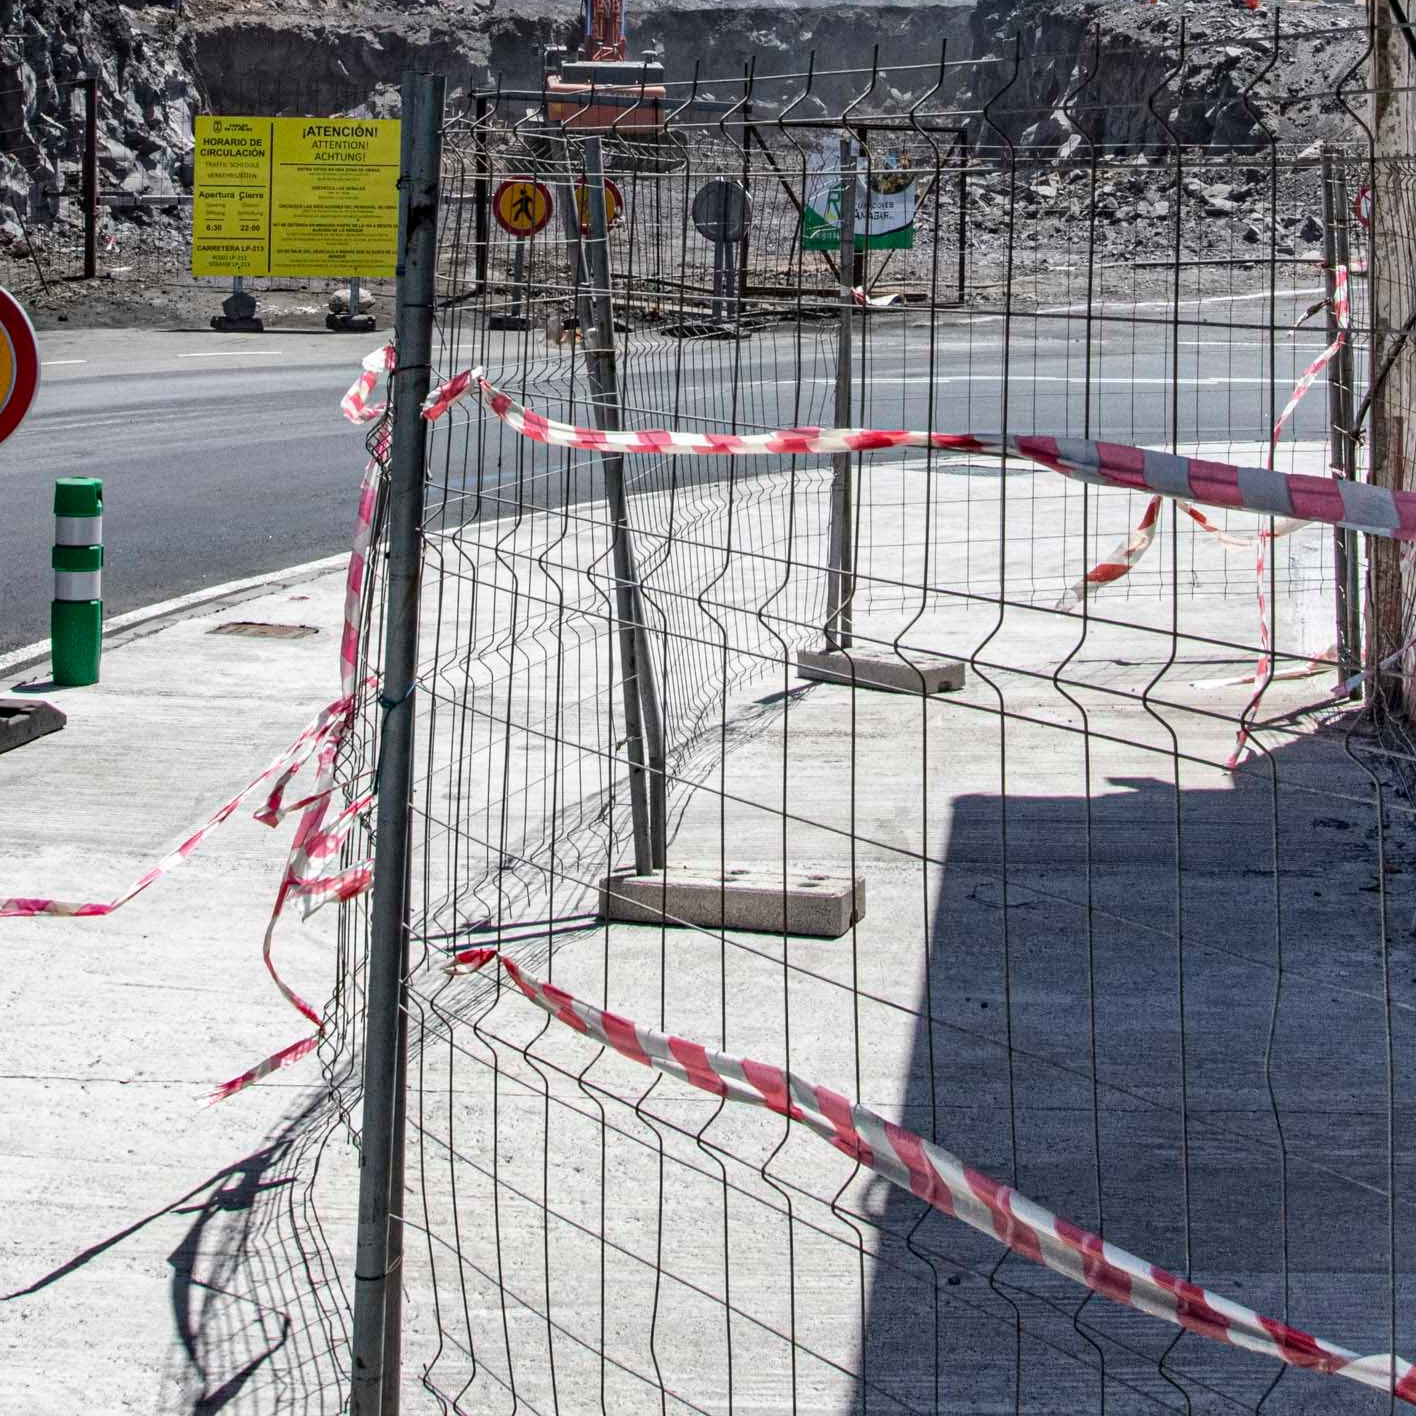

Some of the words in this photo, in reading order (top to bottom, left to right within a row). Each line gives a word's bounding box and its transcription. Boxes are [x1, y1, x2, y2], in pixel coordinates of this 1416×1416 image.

[302, 125, 378, 138] ¡ATENCIÓN!
[203, 137, 248, 146] HORARIO
[249, 138, 263, 147] DE
[311, 140, 369, 150] ATTENTION!
[200, 147, 266, 158] CIRCULACIÓN
[314, 152, 366, 161] ACHTUNG!
[199, 192, 234, 200] Apertura
[238, 191, 264, 200] Cierre
[240, 224, 261, 232] 22:00
